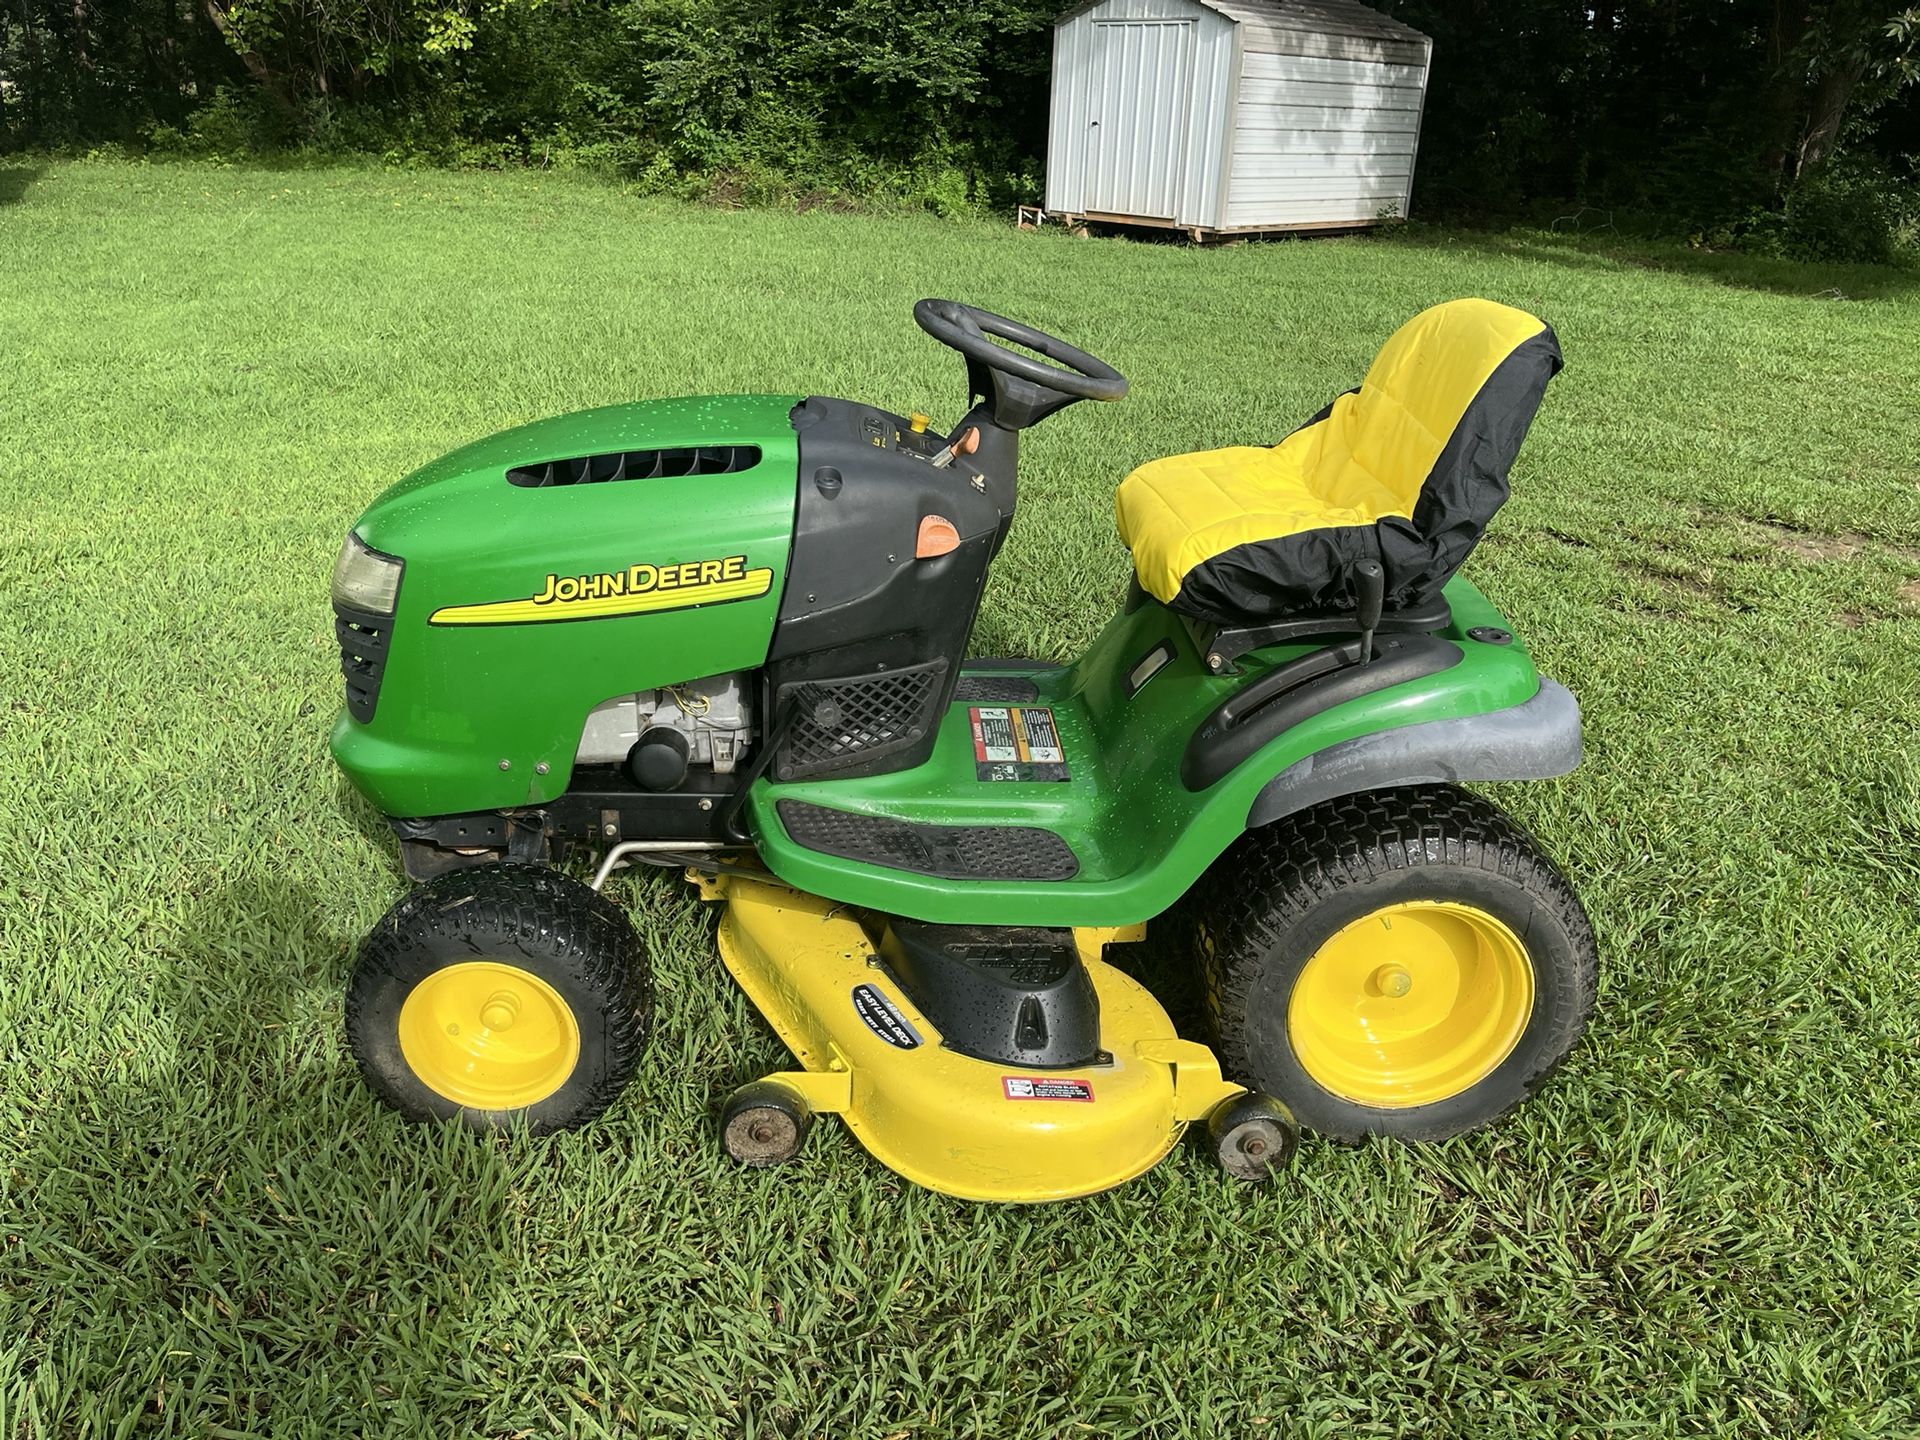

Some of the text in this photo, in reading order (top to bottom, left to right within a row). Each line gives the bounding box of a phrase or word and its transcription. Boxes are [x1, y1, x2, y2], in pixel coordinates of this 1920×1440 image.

[533, 556, 746, 603] JOHN DEERE
[859, 989, 913, 1045] EASY LEVEL DECK
